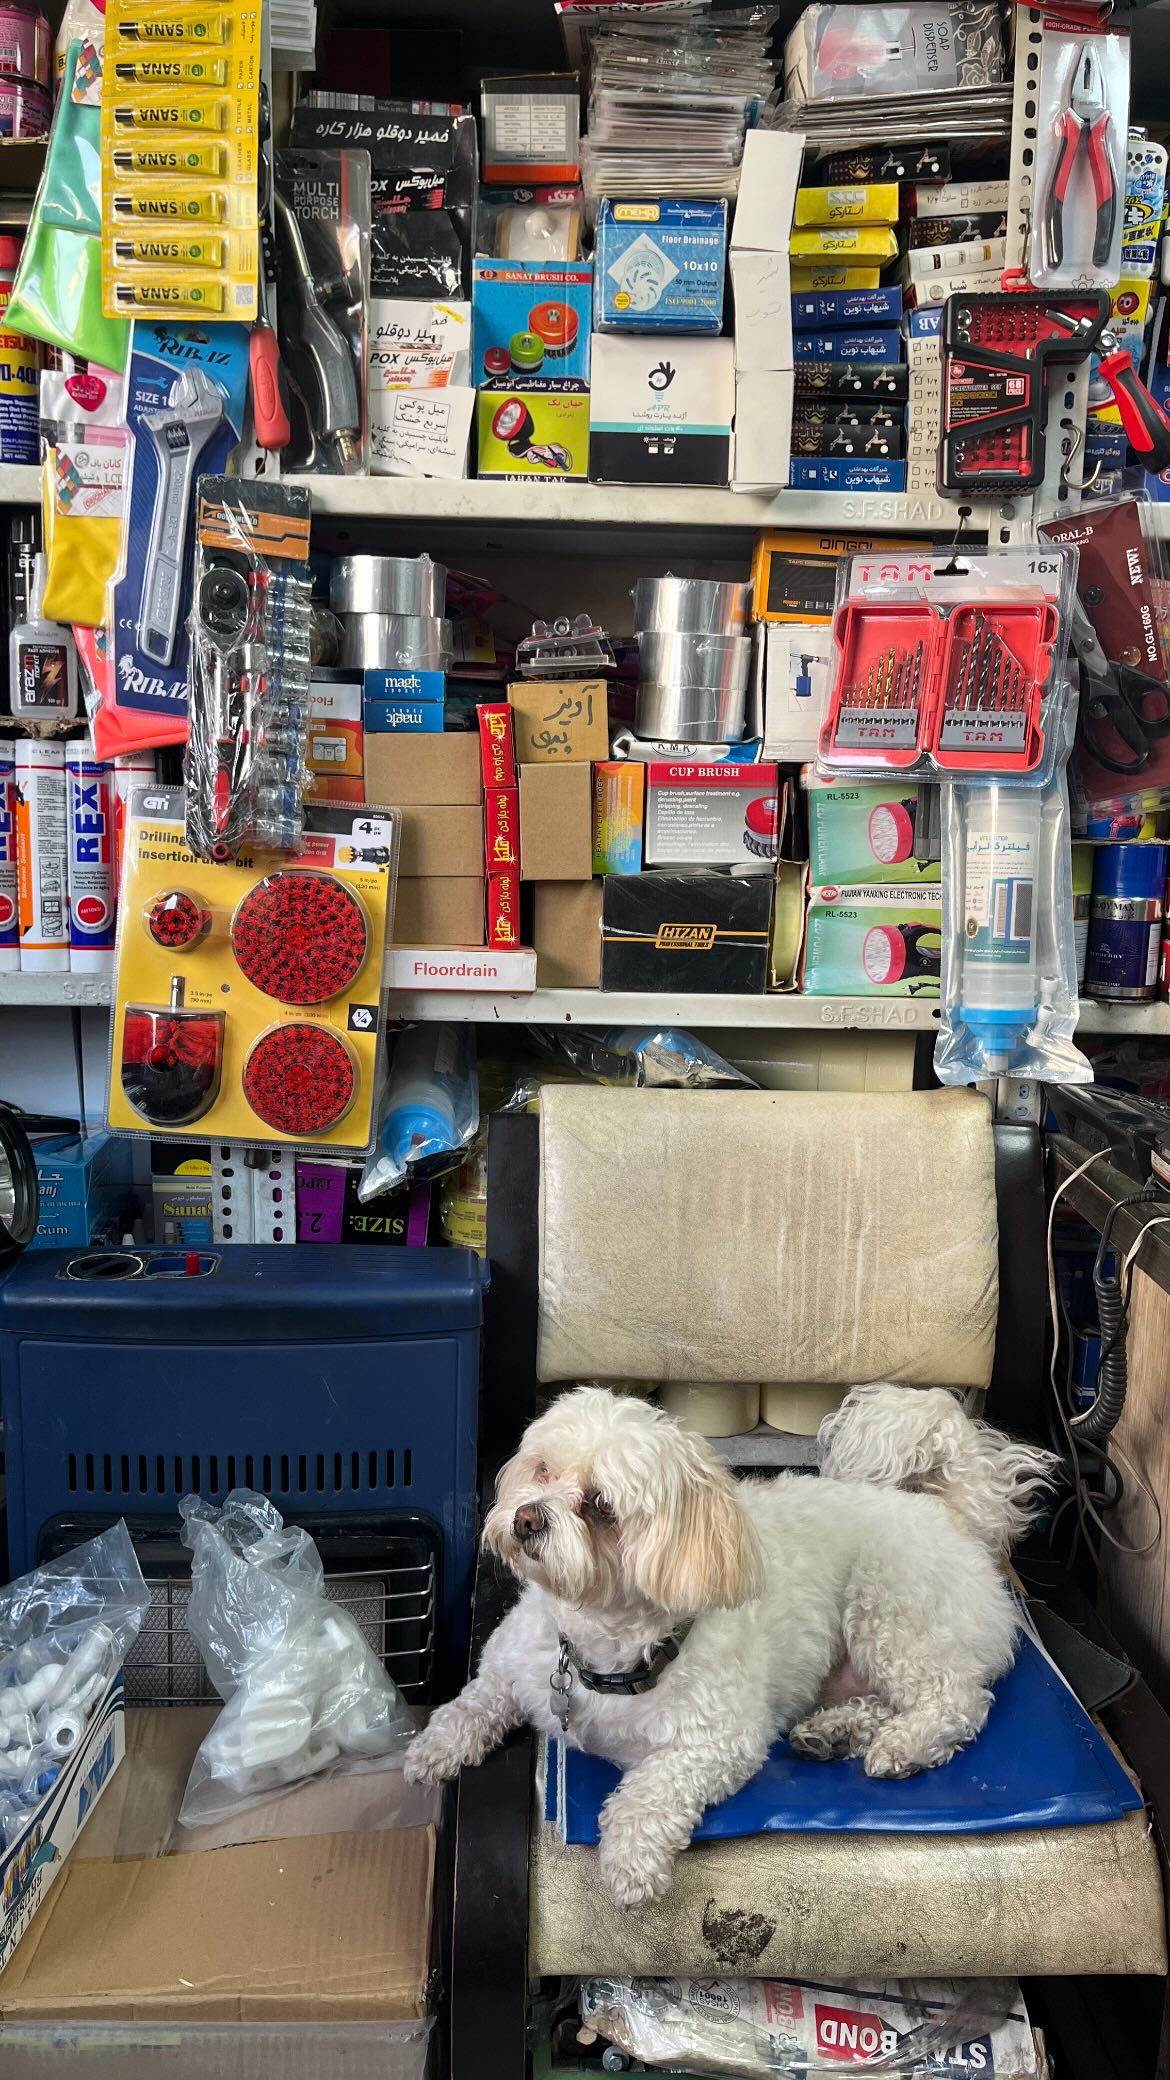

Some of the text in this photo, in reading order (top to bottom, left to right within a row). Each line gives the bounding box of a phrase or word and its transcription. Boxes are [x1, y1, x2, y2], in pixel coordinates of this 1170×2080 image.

[144, 23, 184, 37] SANA
[937, 21, 950, 50] SOAP
[923, 23, 938, 72] DISPENSER
[141, 63, 181, 76] SANA
[139, 109, 179, 122] SANA
[316, 121, 449, 144] خمیر دوقلو هزار کاره
[137, 152, 177, 166] SANA
[294, 182, 339, 196] MULTI
[137, 200, 177, 213] SANA
[294, 196, 339, 206] PURPOSE
[295, 206, 339, 219] TORCH
[829, 207, 864, 218] استارکو
[662, 235, 719, 246] Floor Drainage
[823, 240, 857, 250] استارکو
[139, 244, 179, 257] SANA
[683, 261, 718, 271] 10x10
[565, 274, 579, 282] CO.
[812, 277, 845, 288] استارکو
[141, 287, 180, 299] SANA
[844, 306, 862, 316] نوین
[377, 323, 411, 340] دوقلو
[841, 346, 859, 356] نوین
[370, 353, 400, 364] POX
[492, 379, 580, 391] چراغ سیار مغناطیسی اتومبیل
[1009, 381, 1021, 389] 68
[135, 391, 160, 403] SIZE
[400, 401, 445, 416] میل پوکس
[548, 399, 583, 409] جهان تک
[396, 413, 446, 430] سریع خشک
[845, 475, 863, 484] نوین
[1028, 561, 1058, 574] 16x
[1126, 547, 1144, 586] NEW!
[119, 618, 134, 629] CE
[1140, 605, 1158, 662] NO.GL160G
[385, 674, 422, 689] magic
[386, 712, 422, 727] magic
[494, 767, 506, 781] لوله
[669, 767, 740, 777] CUP BRUSH
[497, 795, 509, 809] لوله
[827, 793, 859, 801] RL-5523
[75, 783, 106, 863] REX
[358, 822, 372, 834] 4
[140, 831, 186, 846] Drilling
[235, 858, 253, 868] bit
[499, 877, 511, 891] لوله
[841, 889, 927, 900] FUJIAN YANXING ELECTRONIC
[1114, 903, 1135, 911] MAX
[825, 911, 857, 919] RL-5523
[663, 927, 711, 939] HIZAN
[413, 962, 498, 977] Floordrain
[350, 1215, 405, 1235] SIZE:
[700, 1990, 728, 2003] 18001
[700, 1997, 730, 2010] OHSAS
[819, 2017, 899, 2052] BOND
